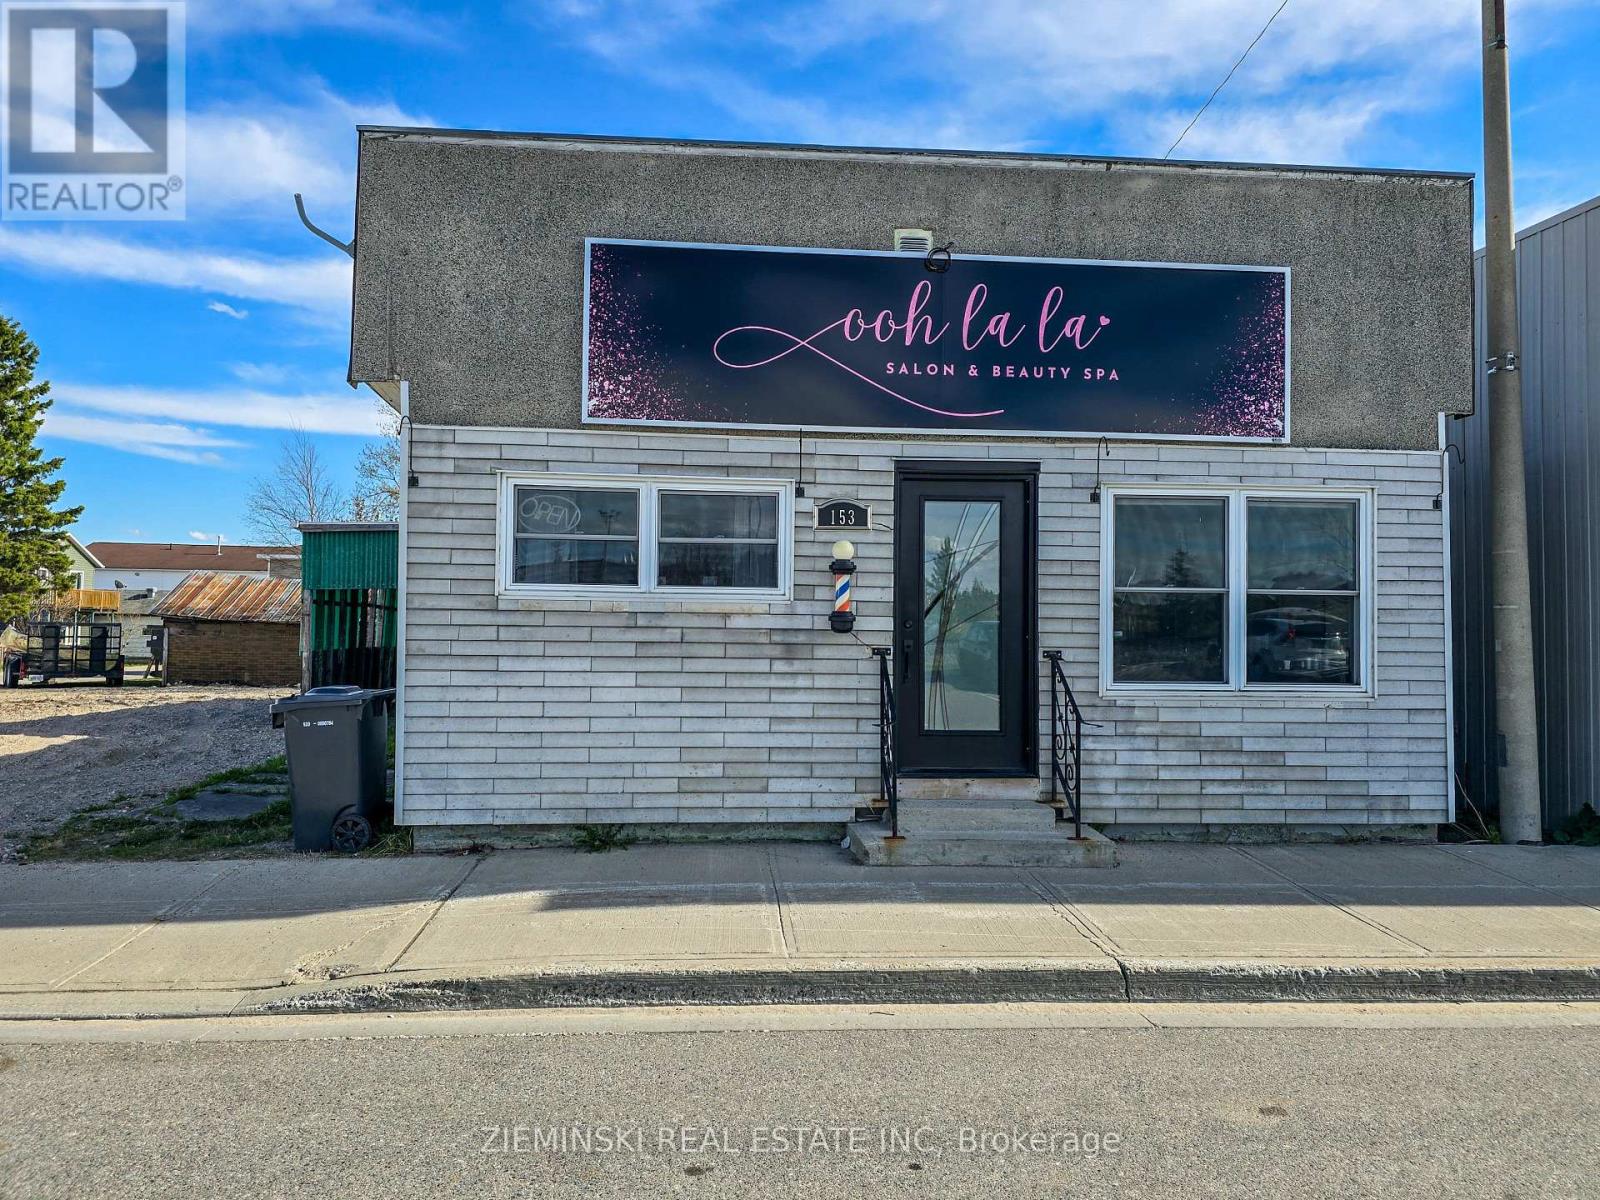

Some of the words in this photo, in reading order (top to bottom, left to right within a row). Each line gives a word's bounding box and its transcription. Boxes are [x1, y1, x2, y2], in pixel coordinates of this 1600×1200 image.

[843, 280, 950, 346] ooh
[962, 284, 1026, 351] la
[1038, 286, 1102, 353] la
[886, 362, 955, 376] SALON
[968, 364, 979, 377] &
[992, 365, 1071, 379] BEAUTY
[1083, 368, 1120, 381] SPA
[520, 497, 579, 529] OPEN
[830, 509, 856, 525] 153
